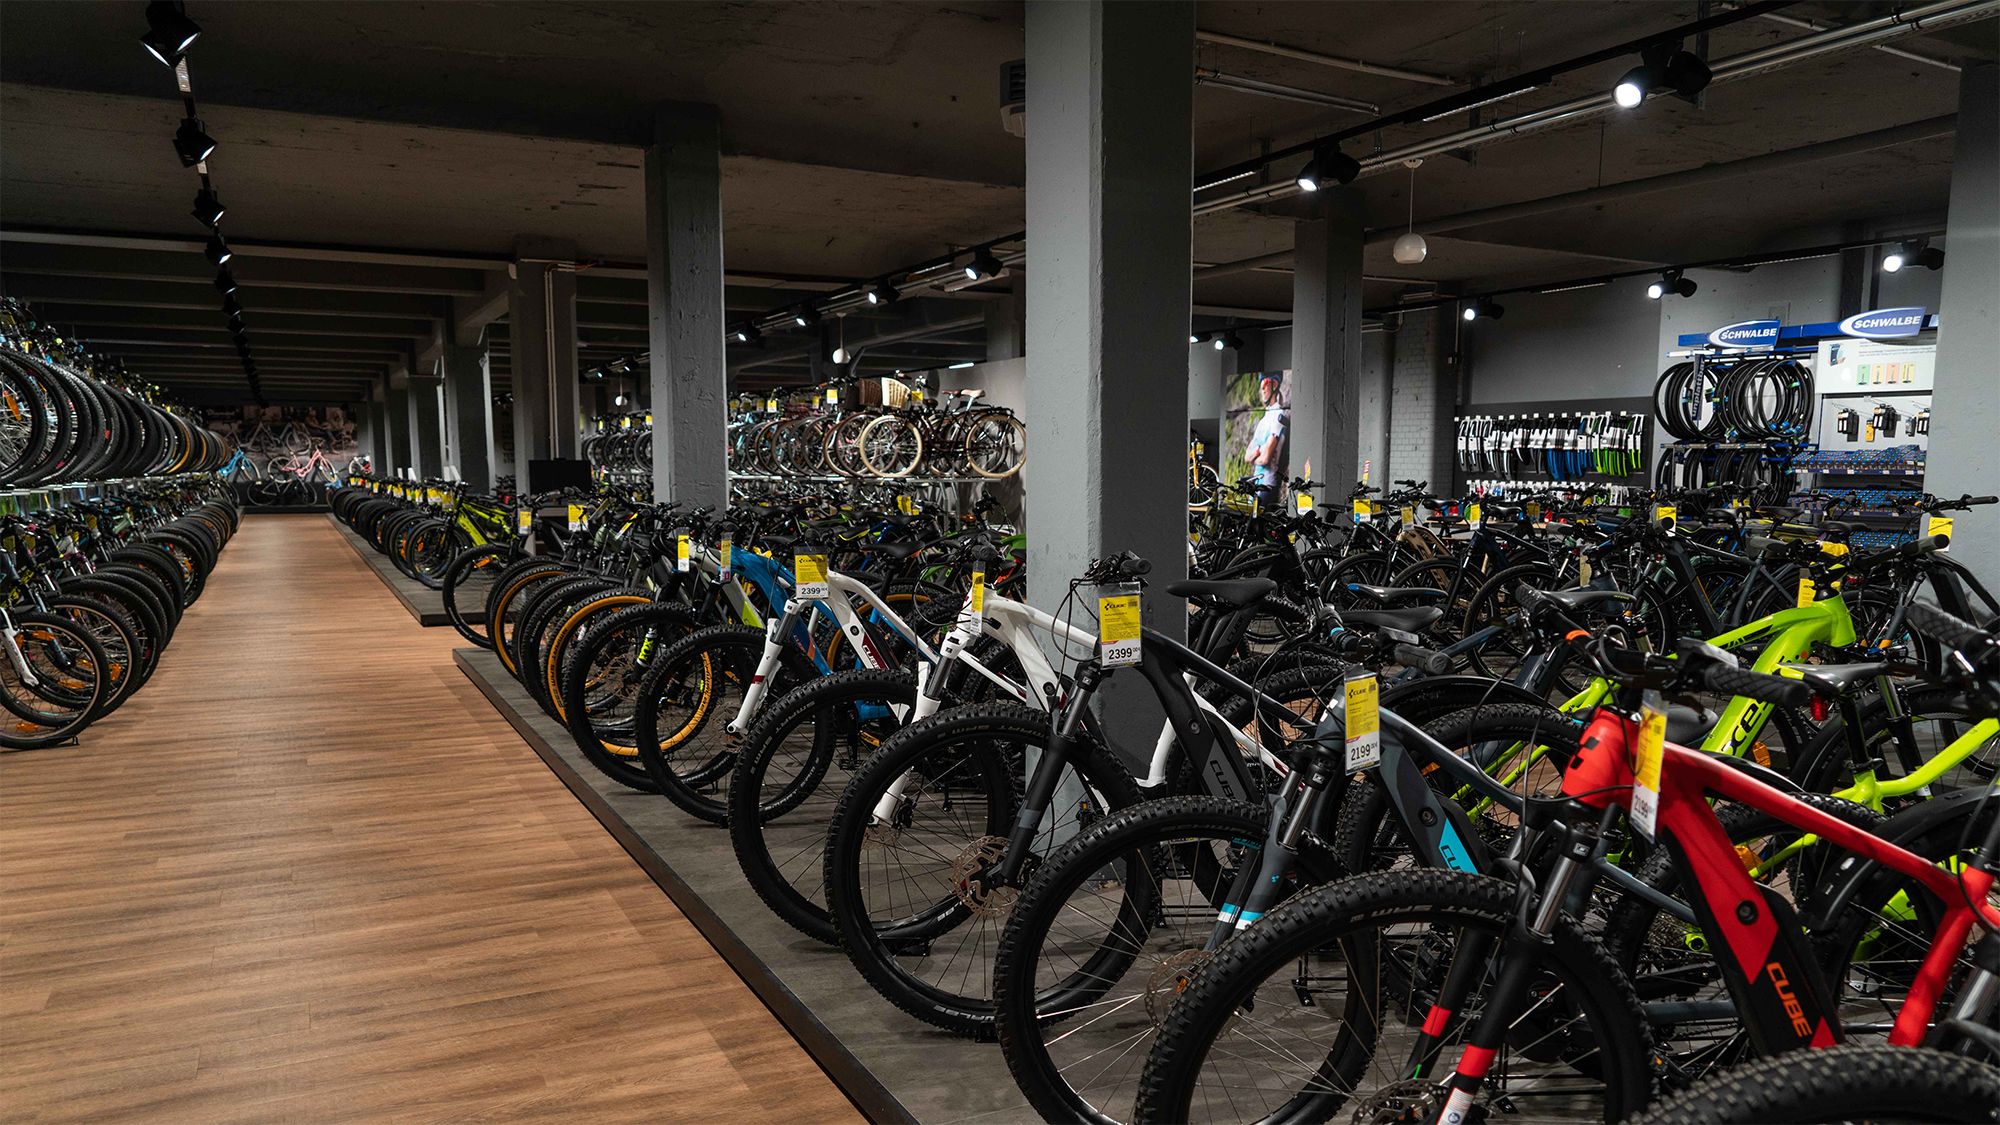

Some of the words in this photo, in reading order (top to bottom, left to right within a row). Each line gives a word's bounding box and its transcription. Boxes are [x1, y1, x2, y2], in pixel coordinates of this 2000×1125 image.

[1854, 315, 1922, 329] SCHWALBE
[1720, 328, 1777, 340] SCHWALBE
[1691, 356, 1705, 419] unplattbar
[801, 587, 821, 595] 2399
[638, 637, 655, 661] FOX
[1108, 647, 1133, 660] 2399
[1350, 743, 1371, 762] 2199
[1210, 760, 1236, 799] CUB
[1440, 844, 1462, 871] CU
[1371, 904, 1433, 918] SAM
[1766, 961, 1813, 1038] CUBE
